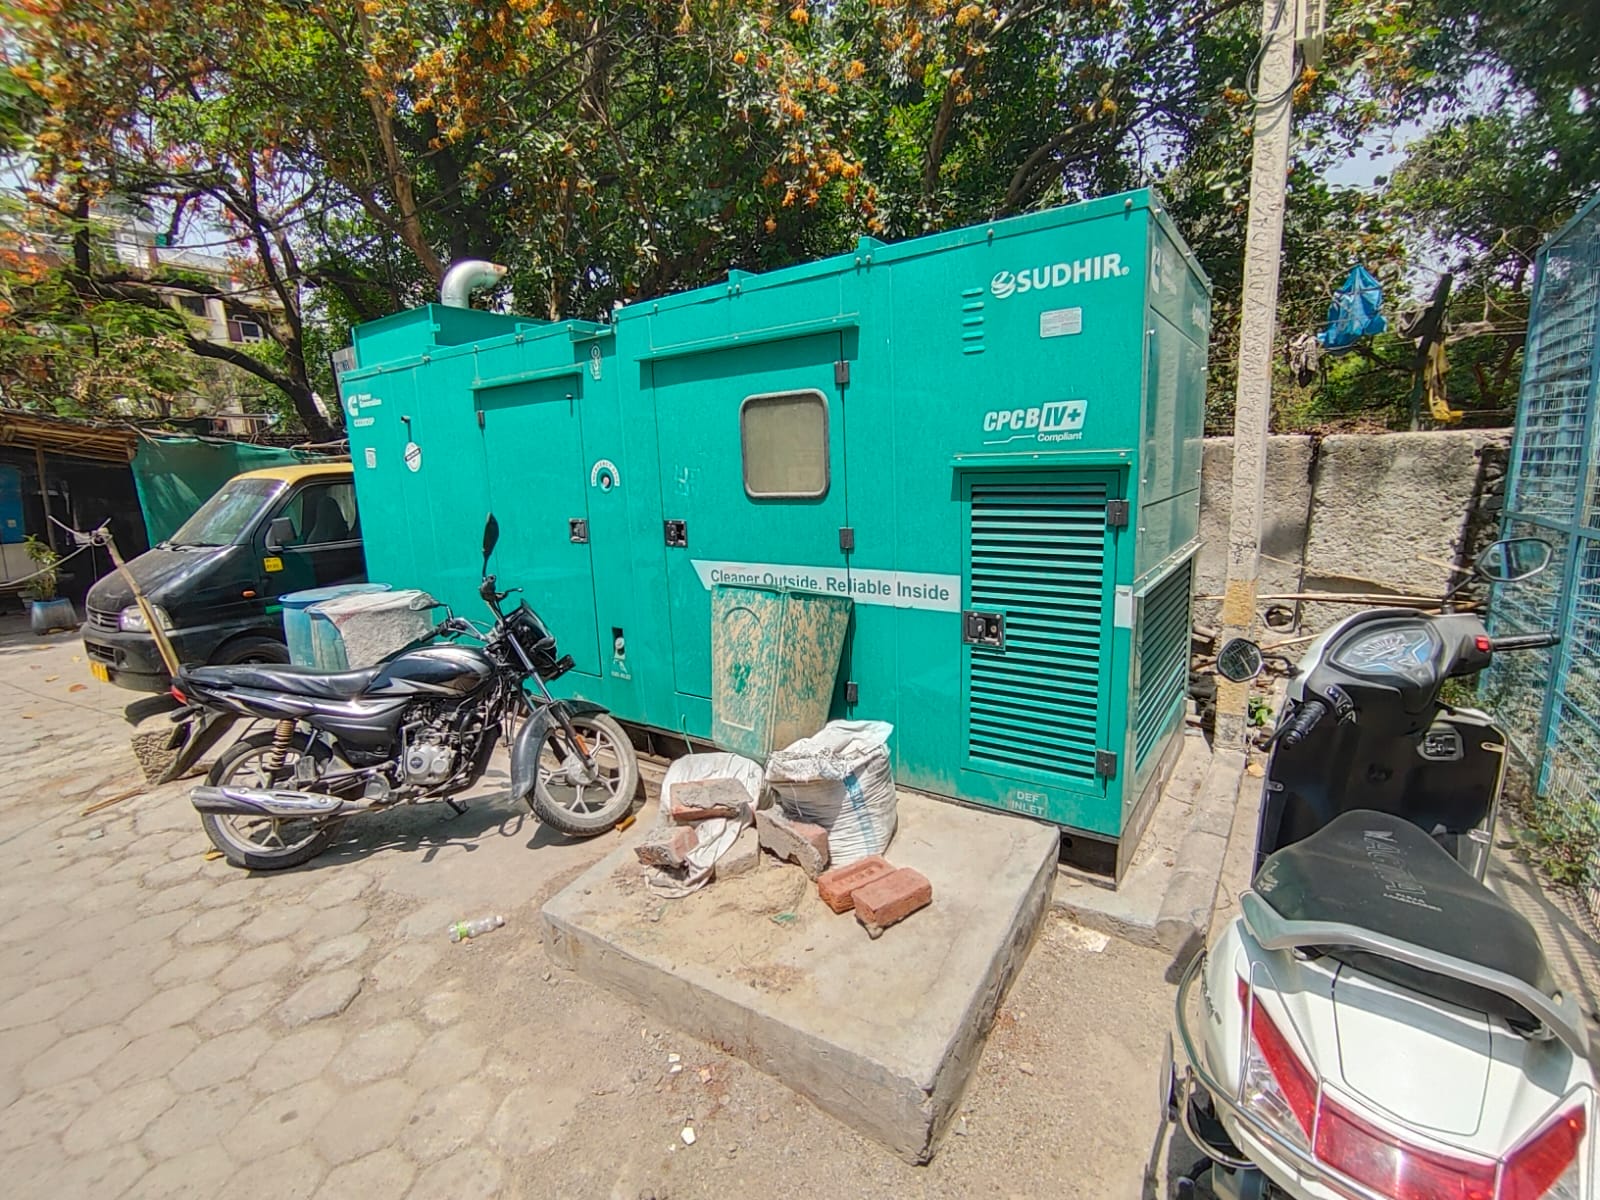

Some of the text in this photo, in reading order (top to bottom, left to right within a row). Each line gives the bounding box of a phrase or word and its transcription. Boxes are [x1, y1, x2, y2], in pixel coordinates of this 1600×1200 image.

[1016, 253, 1121, 293] SUDHIR
[983, 405, 1082, 432] CPCB IV+
[1037, 431, 1083, 443] Compliant
[711, 569, 950, 602] Cleaner Outside. Reliable Inside
[1016, 791, 1039, 802] DEF
[1011, 800, 1045, 816] INLET
